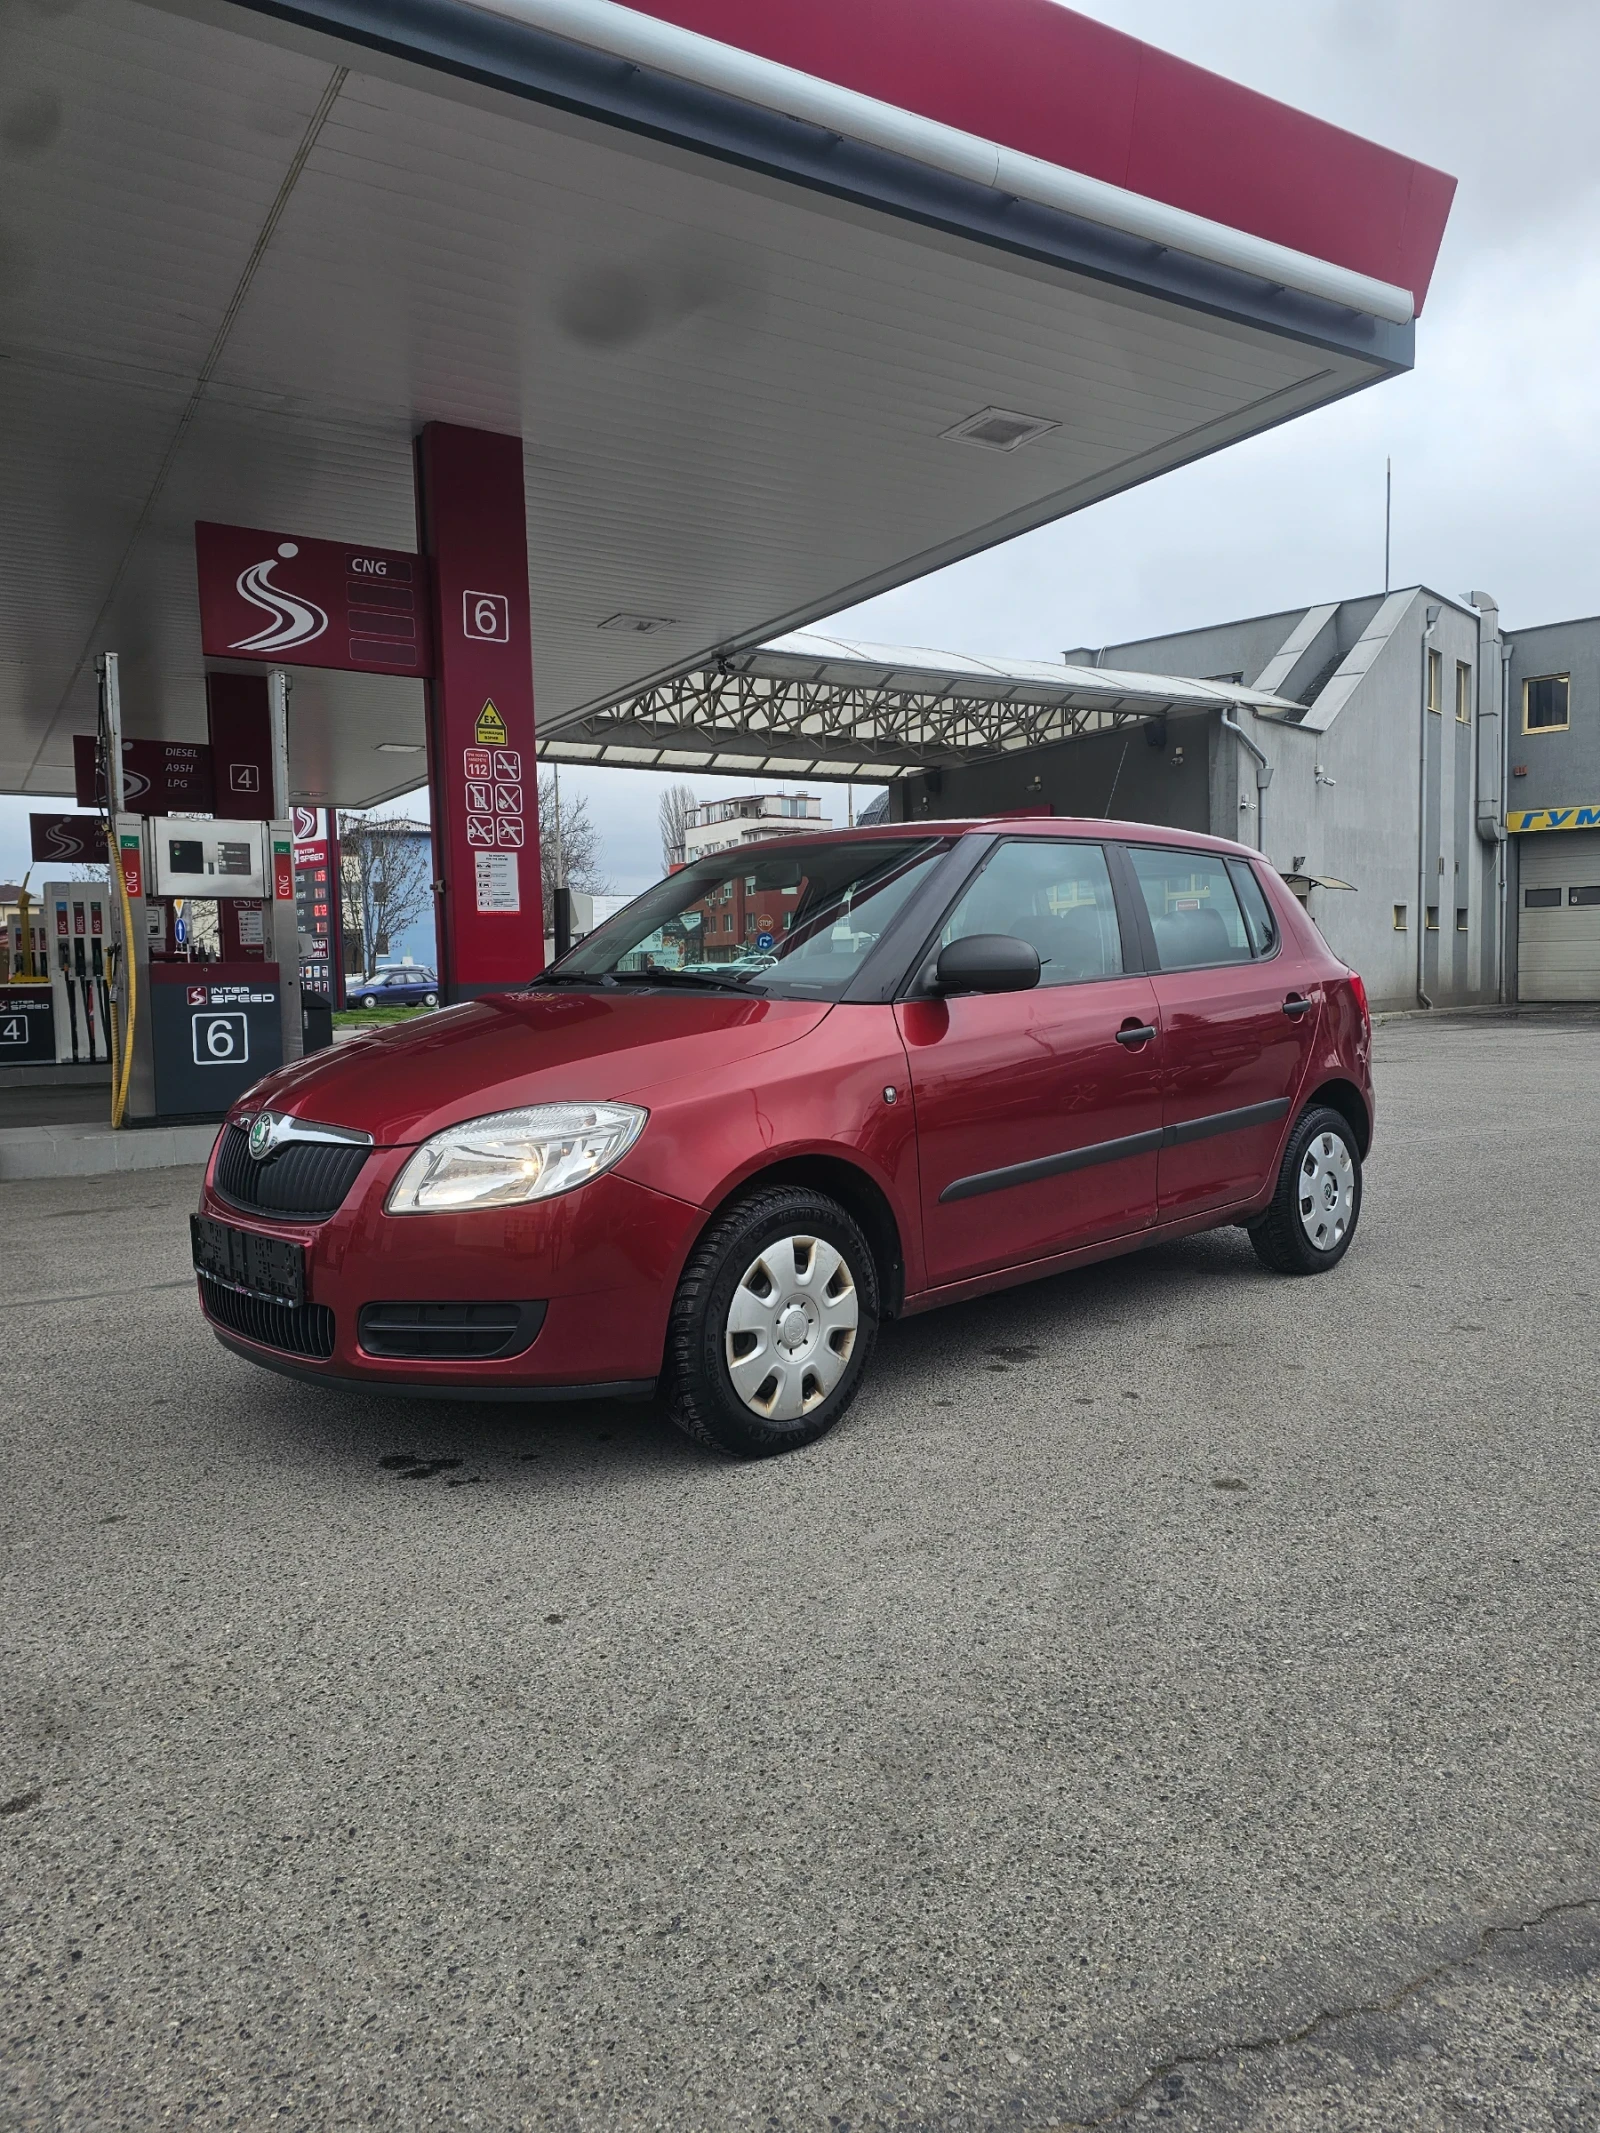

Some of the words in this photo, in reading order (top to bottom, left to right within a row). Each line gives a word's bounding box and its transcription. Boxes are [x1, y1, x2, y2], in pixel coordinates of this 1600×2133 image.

[351, 558, 387, 575] CNG
[474, 599, 497, 634] 6
[484, 715, 496, 724] EX
[165, 747, 198, 758] DIESEL
[165, 763, 194, 773] A95H
[468, 763, 488, 776] 112
[167, 778, 188, 788] LPG
[237, 768, 252, 788] 4
[300, 853, 324, 863] SPEED
[125, 871, 138, 893] CNG
[278, 875, 290, 896] CNG
[59, 921, 67, 934] LPG
[76, 915, 84, 933] DIESEL
[759, 919, 772, 927] STOP
[210, 986, 250, 994] INTER
[210, 993, 275, 1004] SPEED
[3, 1019, 20, 1040] 4
[207, 1019, 234, 1057] 6
